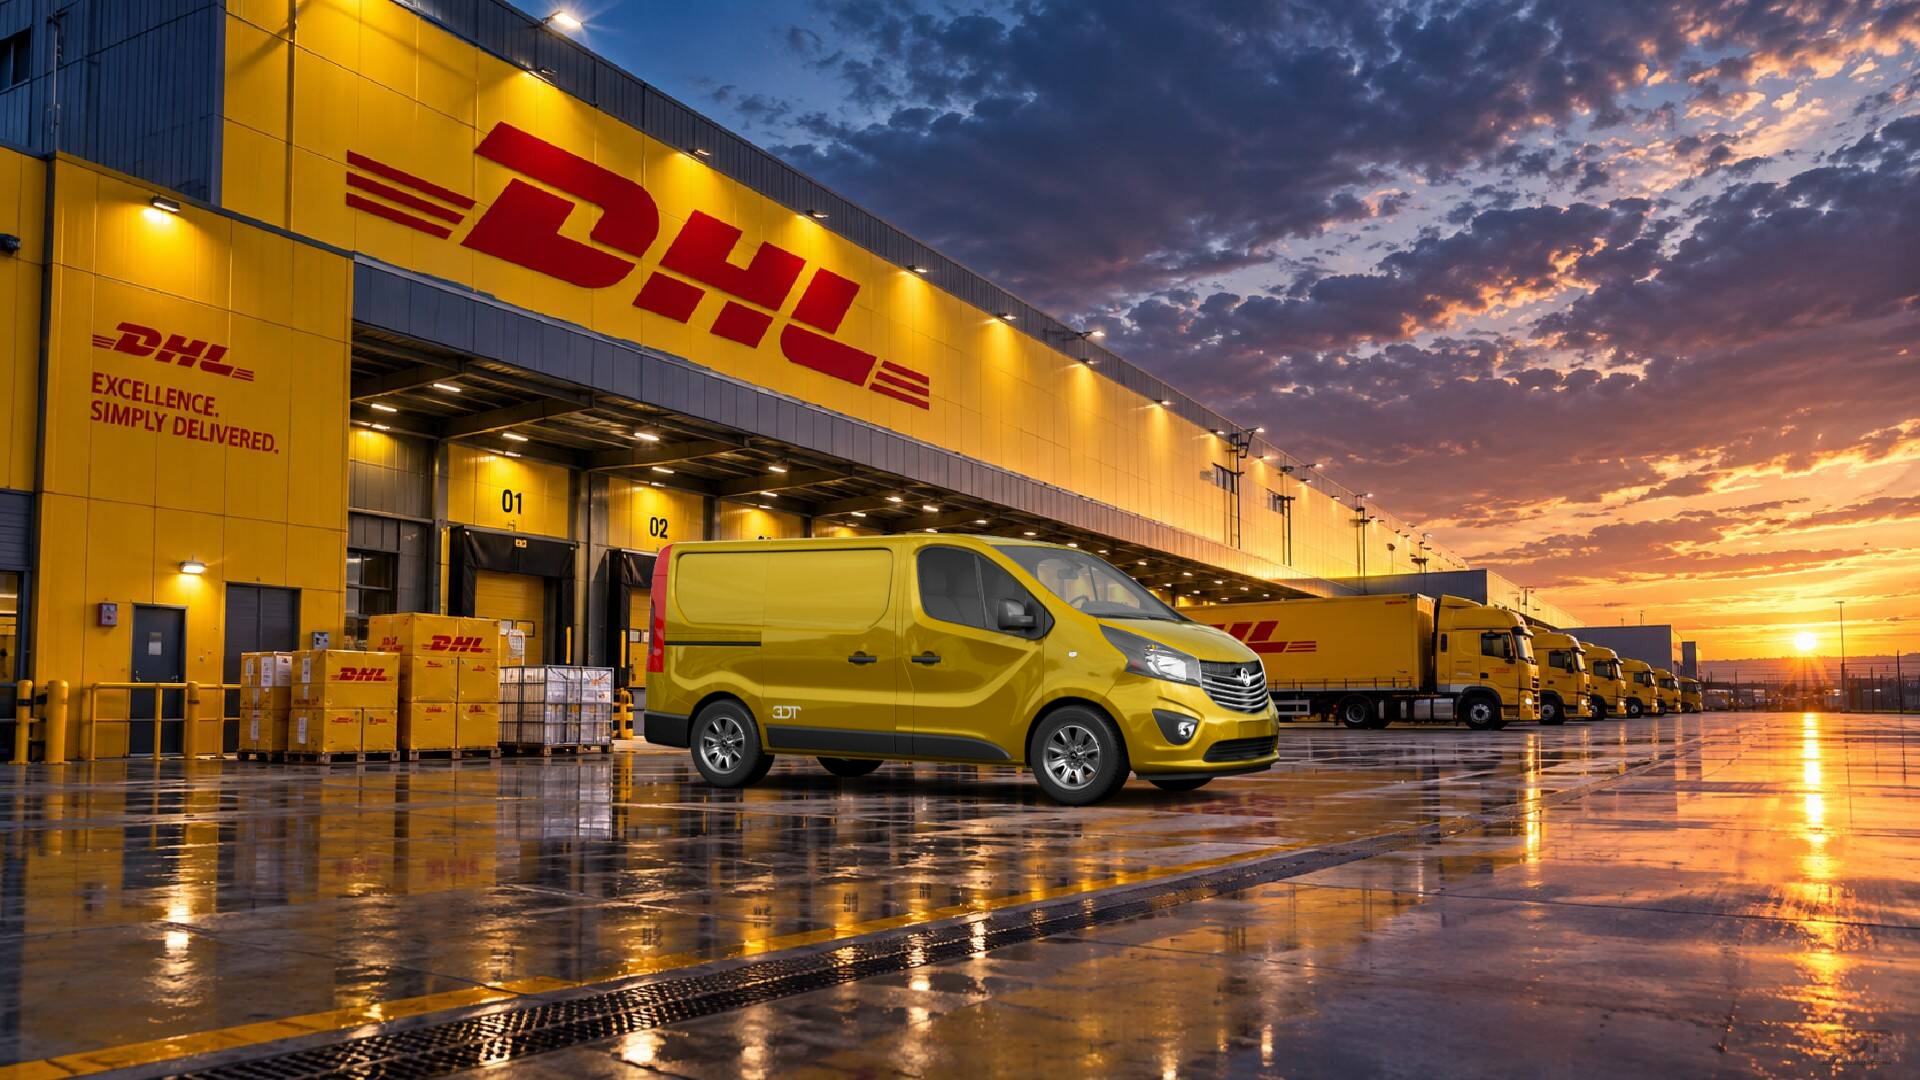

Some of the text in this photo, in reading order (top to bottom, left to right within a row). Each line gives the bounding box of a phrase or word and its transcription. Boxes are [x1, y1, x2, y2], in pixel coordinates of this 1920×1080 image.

[461, 121, 877, 387] DHL
[114, 322, 234, 377] DHL
[91, 372, 219, 417] EXCELLENCE.
[90, 400, 279, 454] SIMPLY DELIVERED.
[502, 489, 522, 515] 01
[650, 517, 668, 540] 02
[430, 635, 484, 653] DHL
[339, 667, 387, 682] DHL
